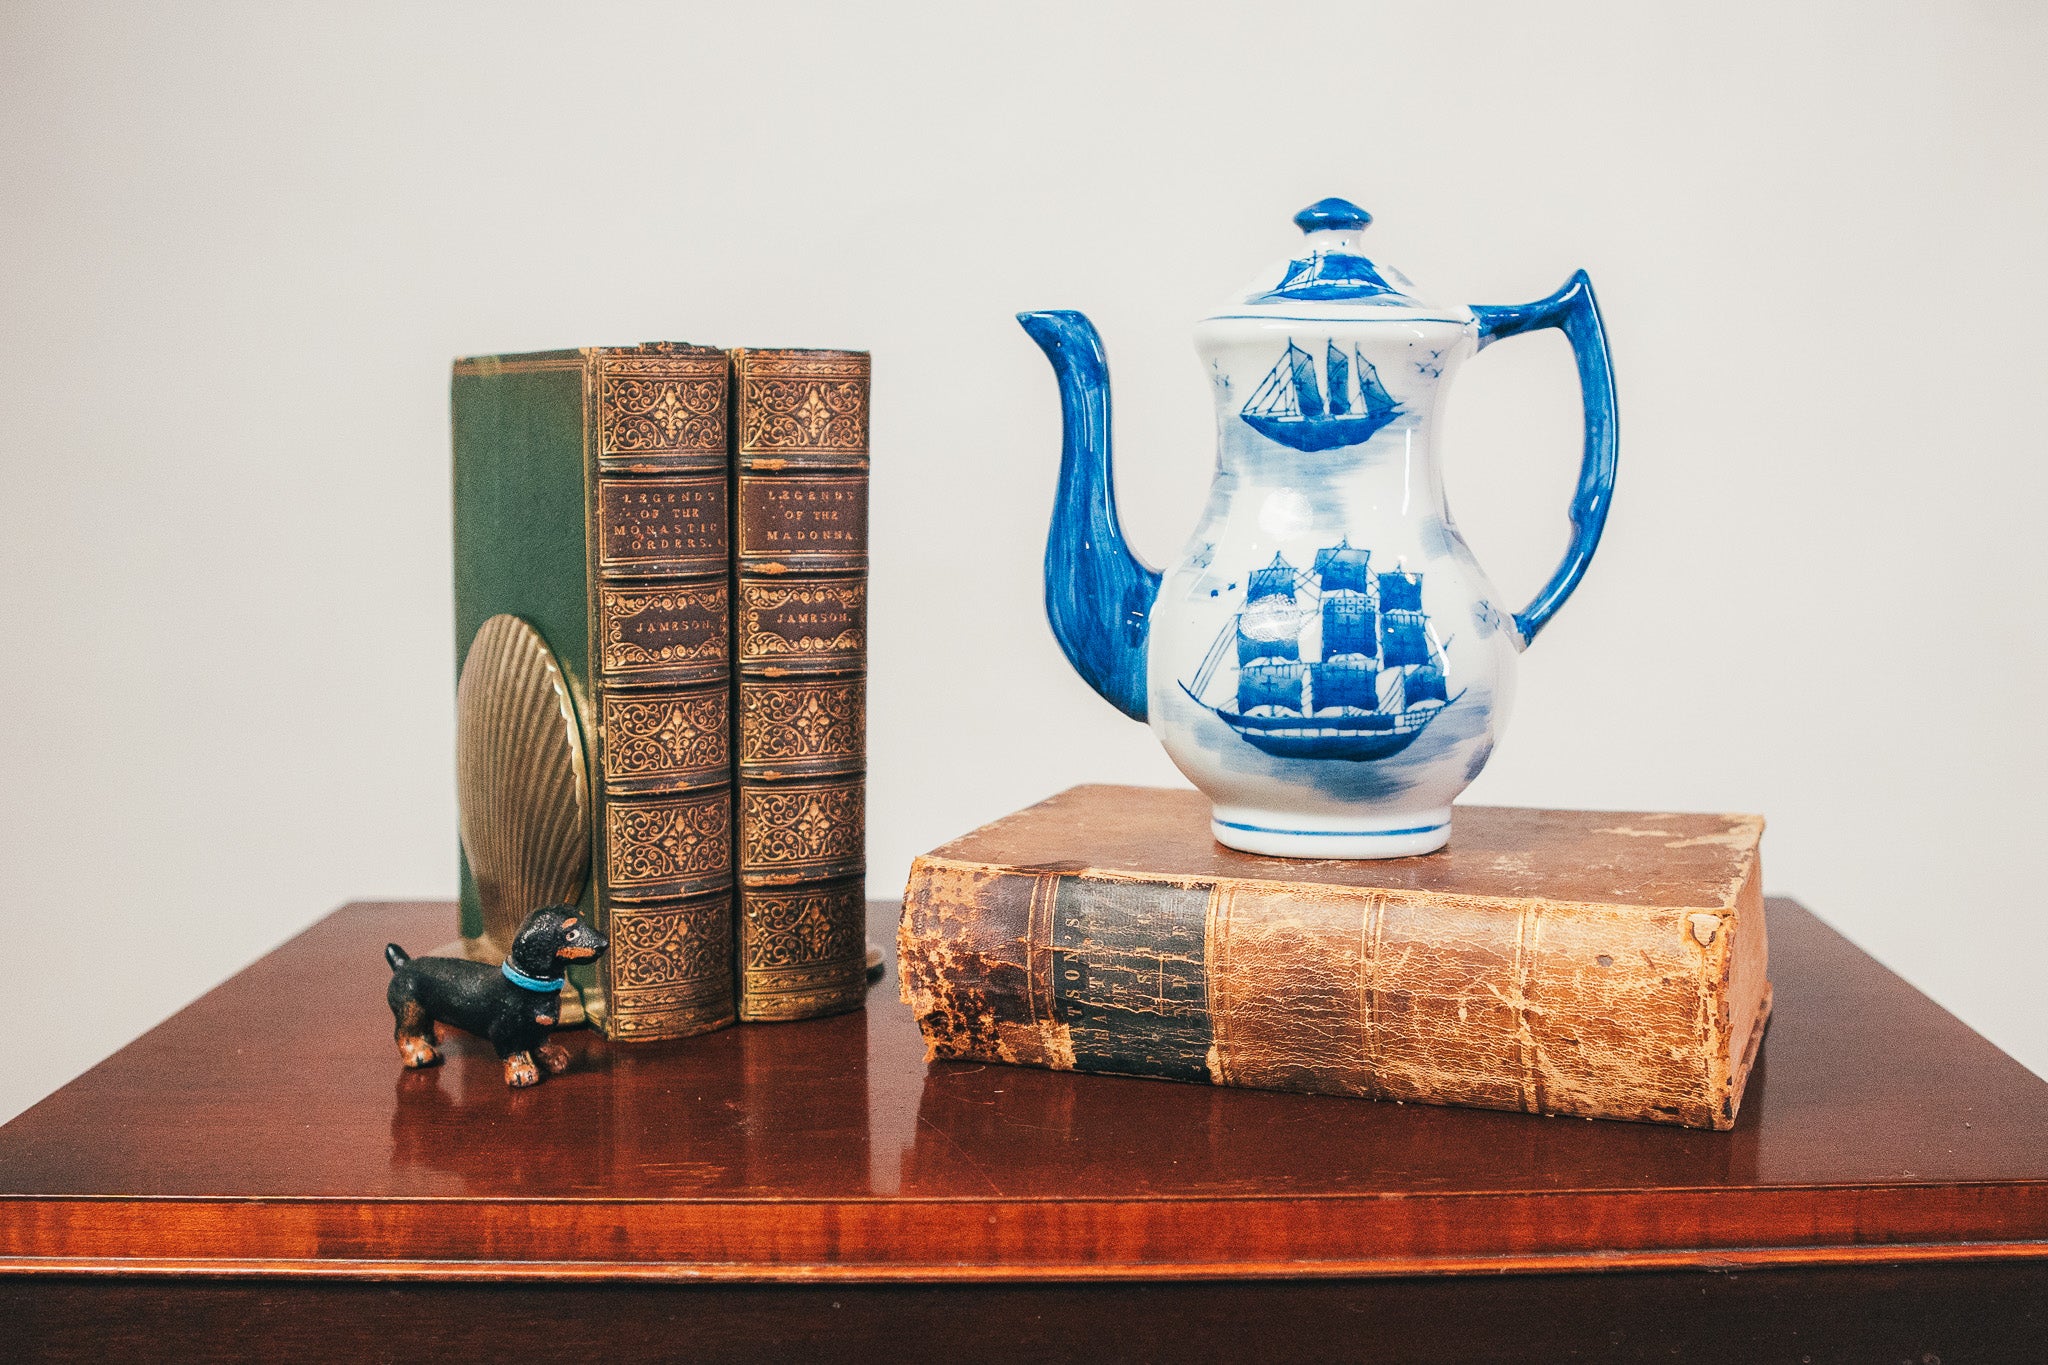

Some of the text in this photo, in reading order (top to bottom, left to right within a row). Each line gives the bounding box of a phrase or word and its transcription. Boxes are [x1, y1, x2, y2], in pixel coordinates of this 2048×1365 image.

[622, 491, 715, 504] LEGENDS
[768, 491, 855, 502] LEGENDS
[640, 508, 699, 519] OF THE
[785, 510, 838, 520] OF THE
[614, 523, 717, 536] MONASTIC
